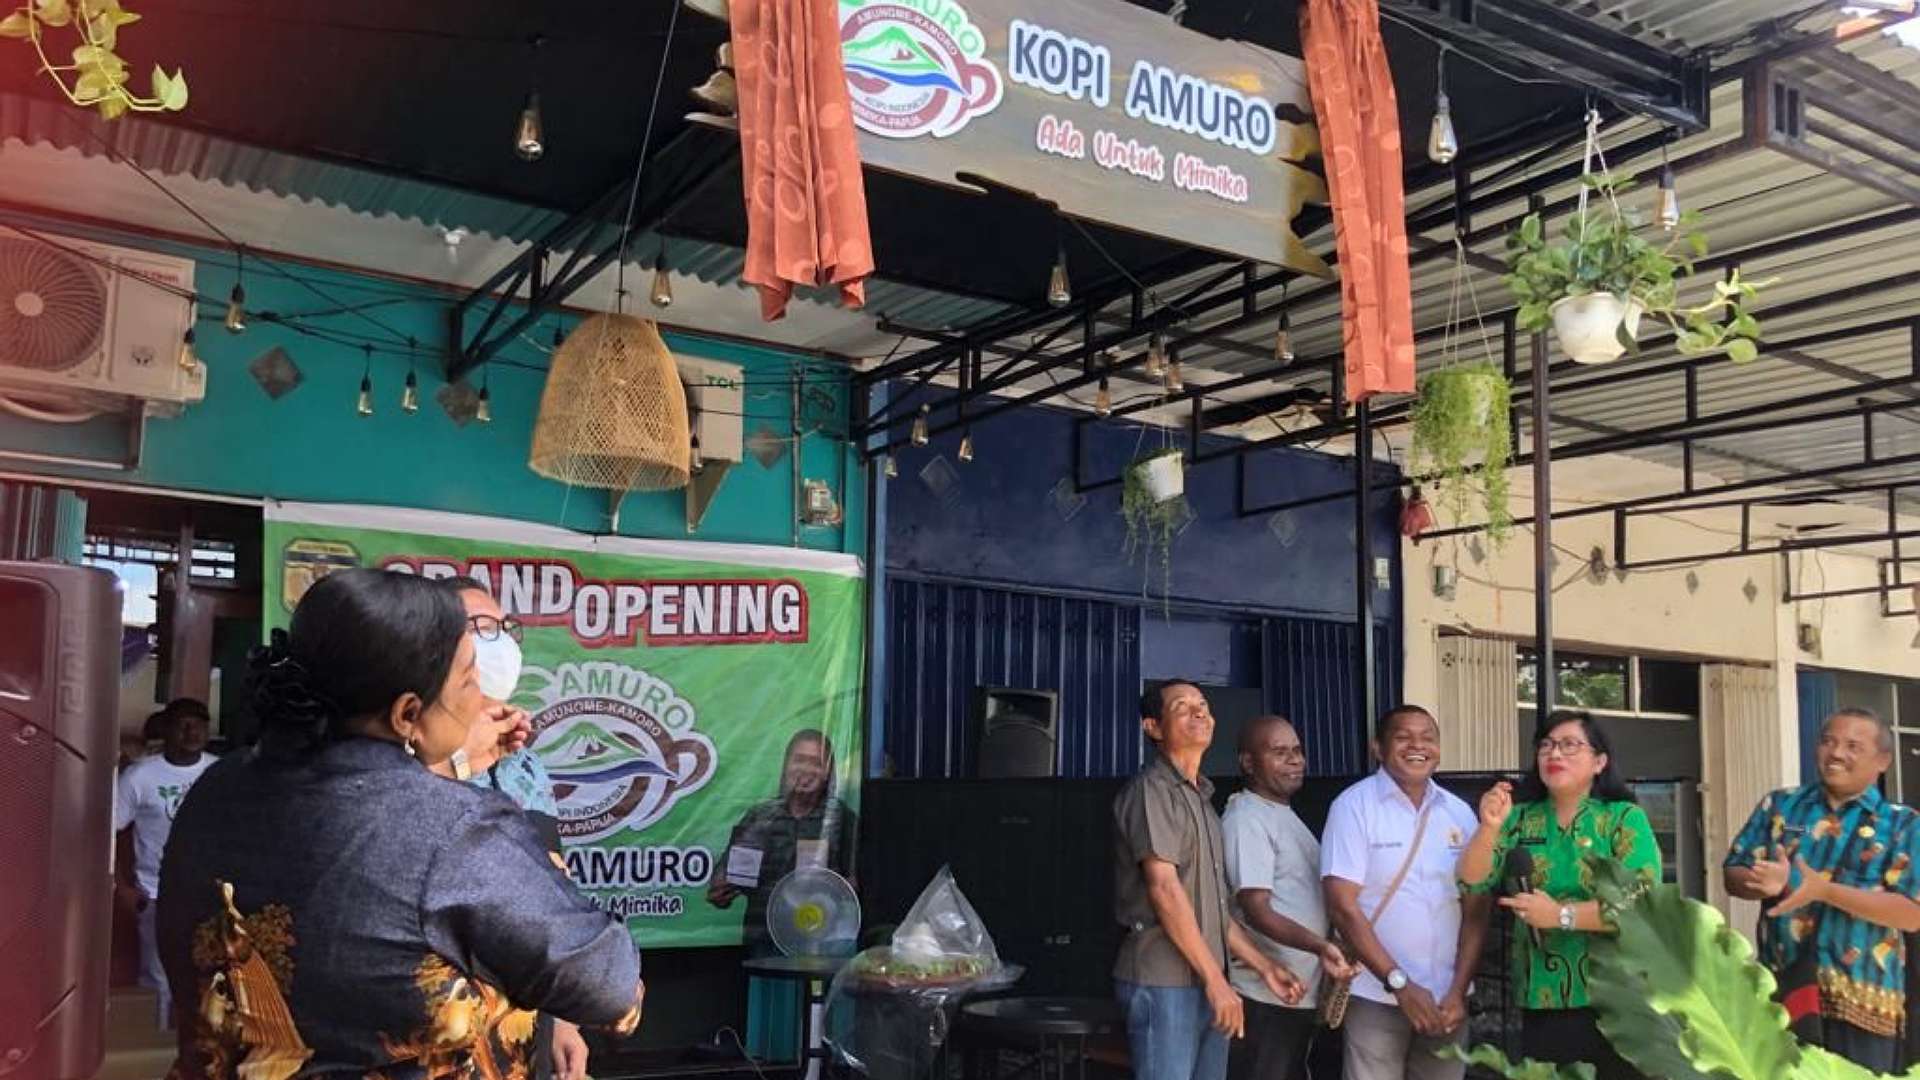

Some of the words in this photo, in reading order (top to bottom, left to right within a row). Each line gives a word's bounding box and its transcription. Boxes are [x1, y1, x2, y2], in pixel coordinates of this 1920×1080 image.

[904, 0, 979, 54] URO
[1015, 27, 1104, 99] KOPI
[1131, 68, 1270, 147] AMURO
[1040, 118, 1082, 155] Ada
[1096, 133, 1162, 177] Untuk
[1177, 154, 1247, 199] Mimika
[704, 374, 739, 391] TCL
[384, 563, 573, 616] AND
[574, 584, 800, 638] OPENING
[536, 699, 661, 737] AMUNGME-KAMORO
[560, 669, 686, 730] AMURO
[566, 850, 710, 884] AMURO
[610, 895, 683, 916] Mimika
